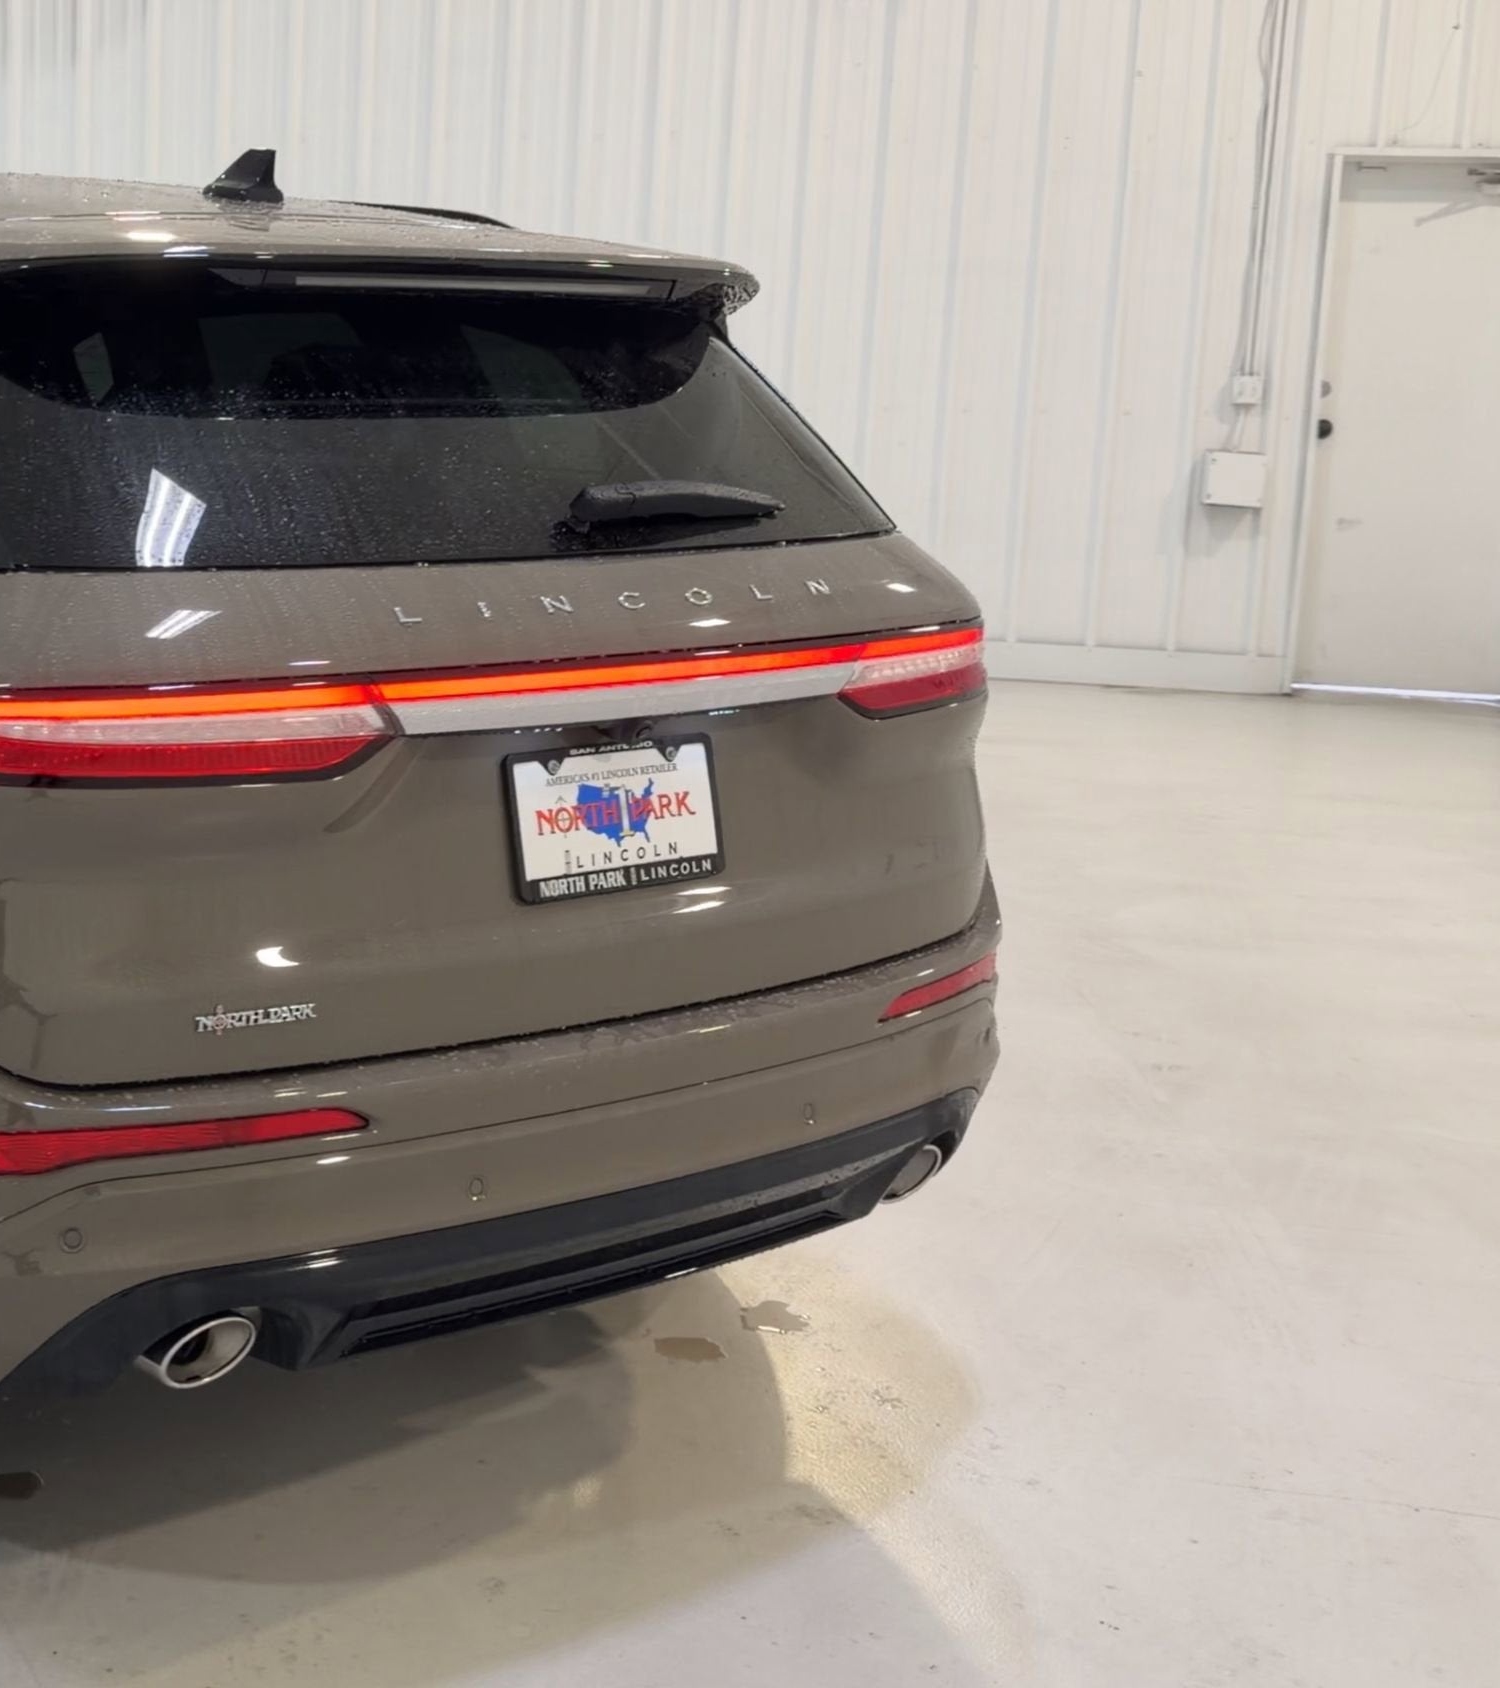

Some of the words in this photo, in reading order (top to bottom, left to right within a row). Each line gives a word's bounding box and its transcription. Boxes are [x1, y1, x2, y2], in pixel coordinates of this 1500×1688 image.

[393, 578, 831, 625] LINCOLN
[569, 746, 597, 756] SAN
[601, 767, 638, 781] LINCOLN
[639, 763, 678, 776] RETAILER
[535, 800, 621, 836] NORTH
[632, 791, 696, 822] PARK
[575, 841, 678, 869] LINCOLN
[539, 877, 587, 898] NORTH
[589, 868, 627, 891] PARK
[640, 858, 713, 881] LINCOLN
[195, 1008, 265, 1033] NORTH
[266, 1003, 317, 1023] PARK
